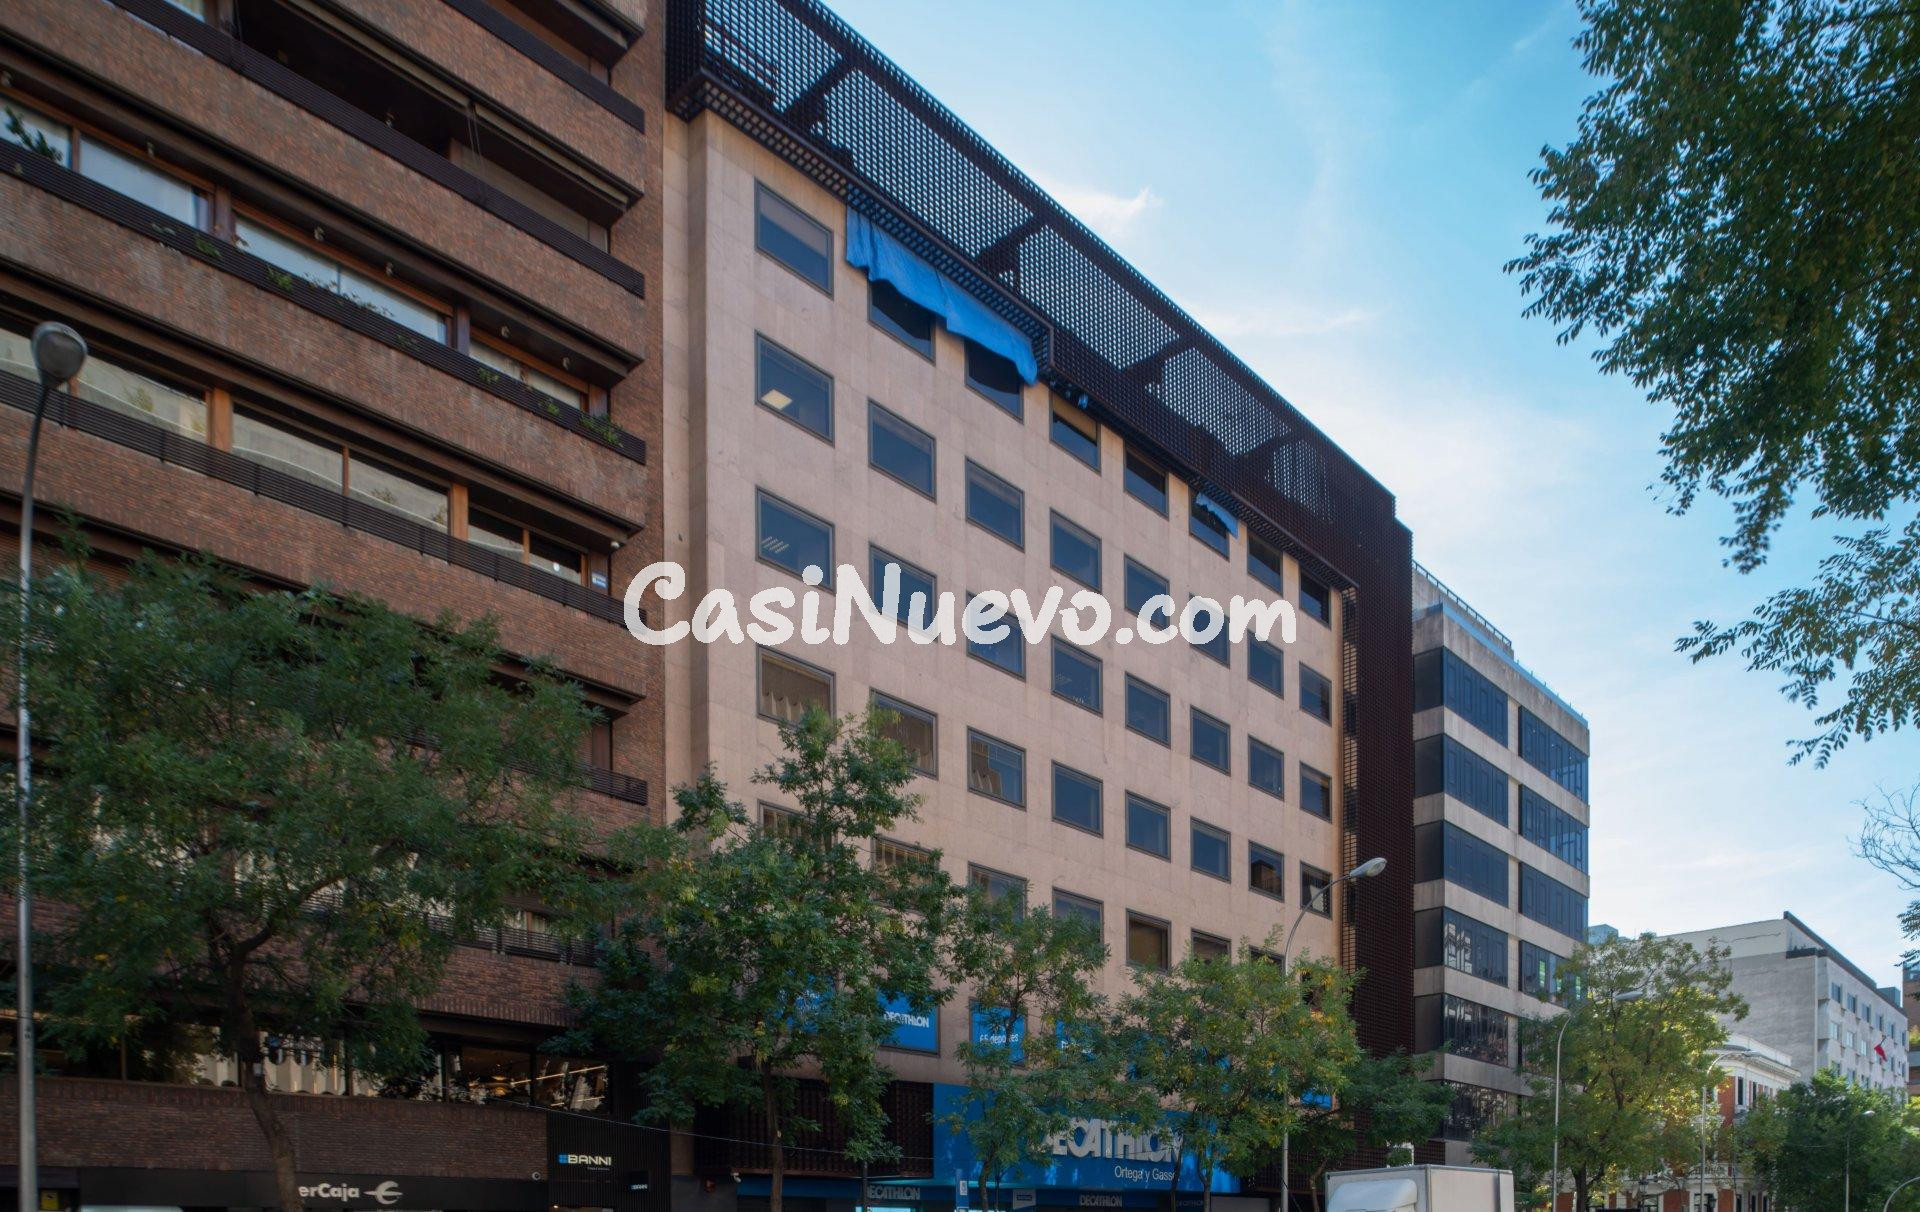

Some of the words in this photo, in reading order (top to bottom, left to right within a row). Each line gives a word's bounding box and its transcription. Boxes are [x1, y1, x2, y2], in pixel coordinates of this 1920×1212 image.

[990, 1034, 1019, 1045] depotes
[1043, 1117, 1185, 1163] ECATHLON
[568, 1154, 612, 1166] BANNI
[1114, 1165, 1143, 1182] Ortega
[1145, 1171, 1150, 1182] y
[1152, 1168, 1179, 1181] Gass
[298, 1182, 360, 1202] erCaja
